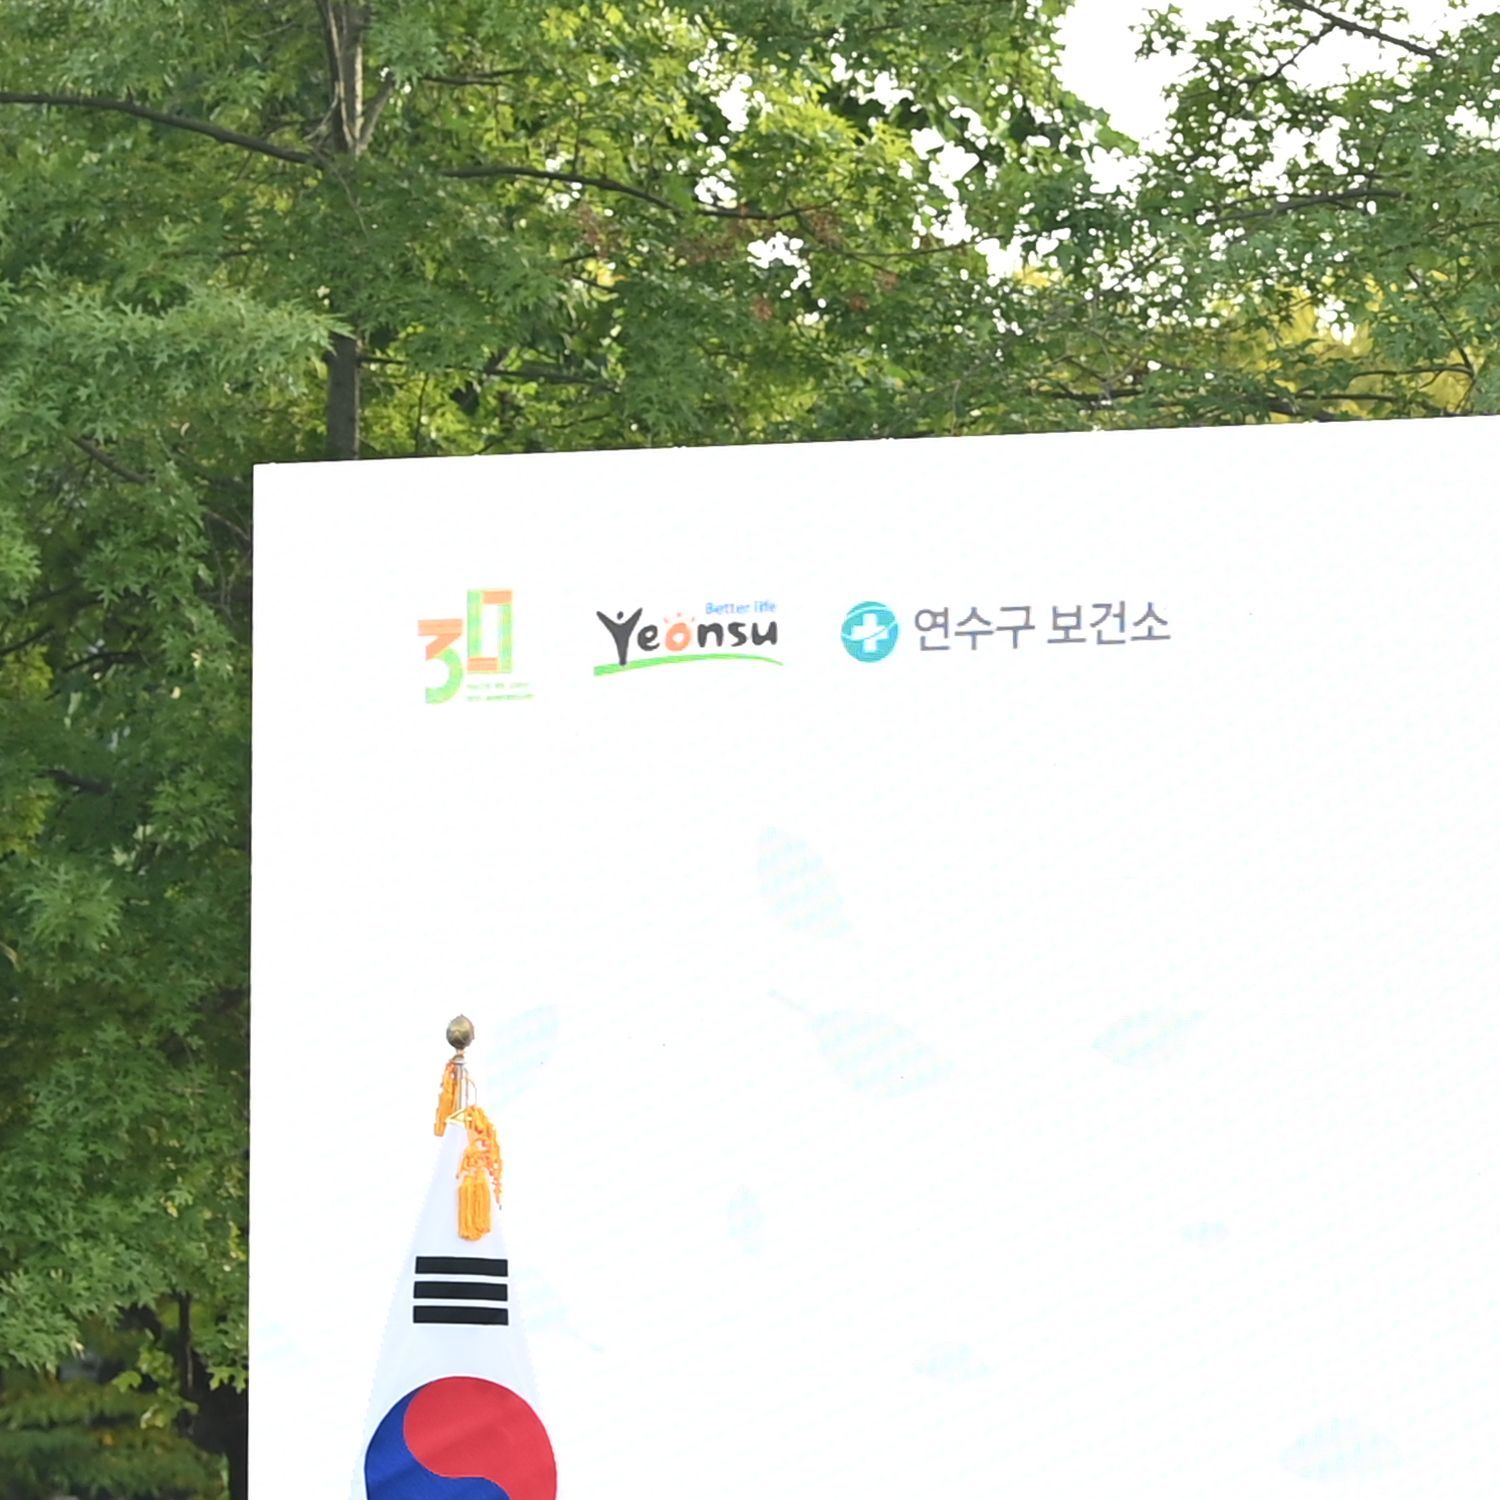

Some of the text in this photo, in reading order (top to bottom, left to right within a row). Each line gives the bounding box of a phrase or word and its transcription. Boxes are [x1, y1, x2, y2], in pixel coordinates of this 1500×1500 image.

[705, 601, 750, 615] Better
[913, 601, 1171, 651] 연수구 보건소
[596, 607, 778, 666] Yeonsu
